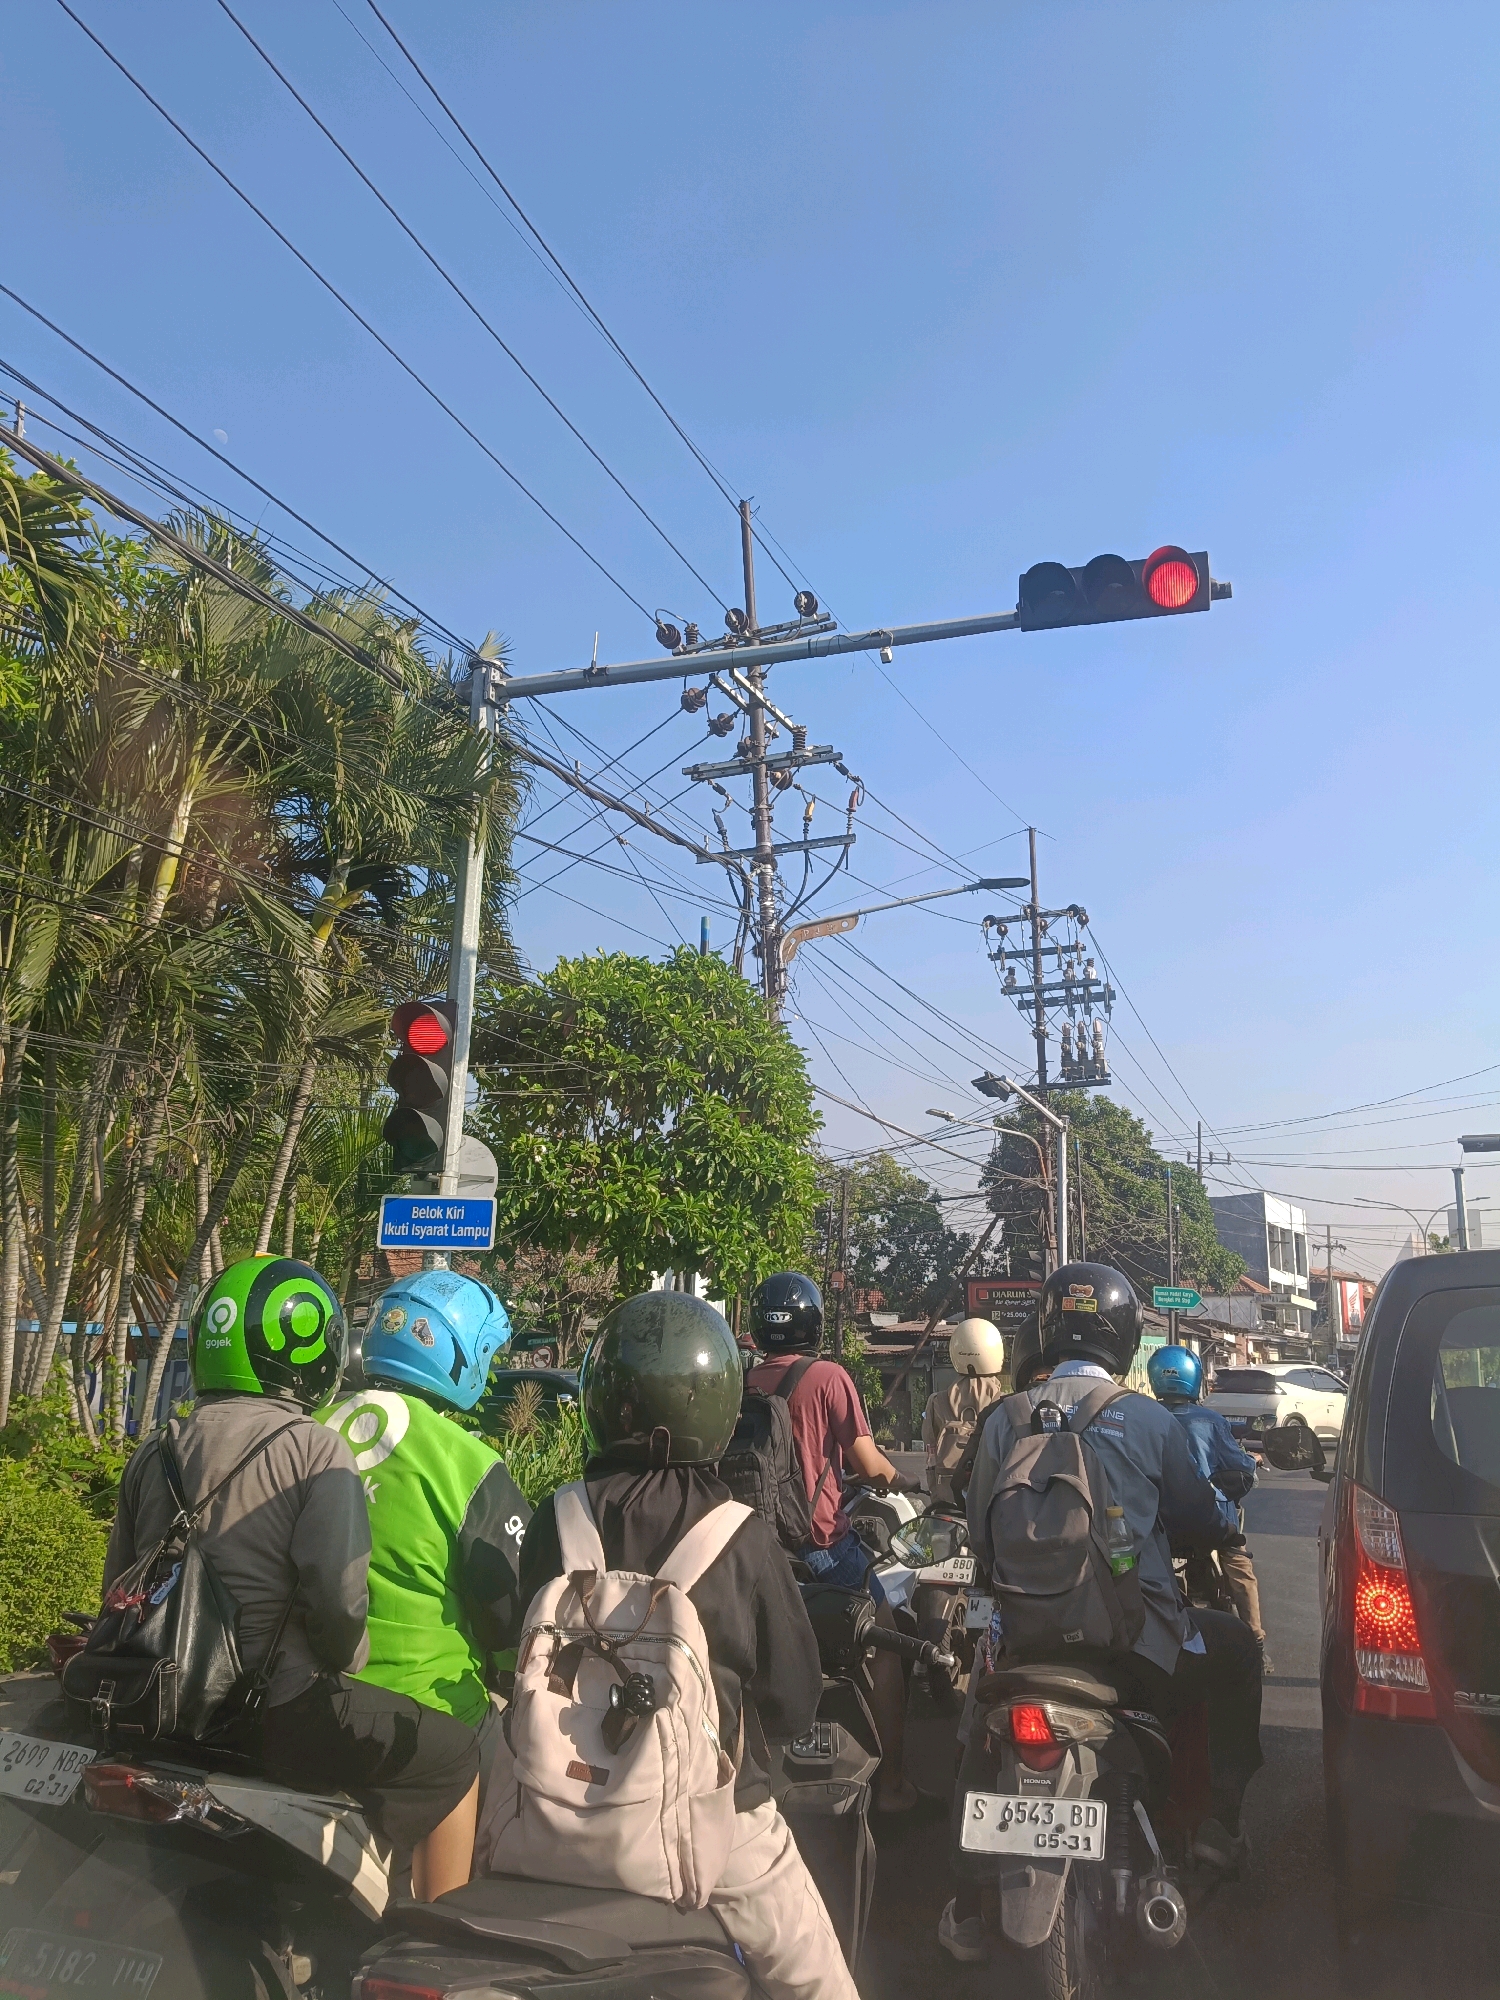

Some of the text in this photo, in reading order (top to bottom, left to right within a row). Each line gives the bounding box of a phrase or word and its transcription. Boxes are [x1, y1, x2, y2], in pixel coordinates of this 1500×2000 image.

[411, 1206, 465, 1219] Belok Kiri
[384, 1222, 489, 1240] Ikuti Isyarat Lampu
[766, 1313, 790, 1321] KYT
[206, 1337, 232, 1349] gojek
[970, 1599, 980, 1611] W
[3, 1740, 50, 1768] 2699
[973, 1799, 1099, 1828] S 6543 BD
